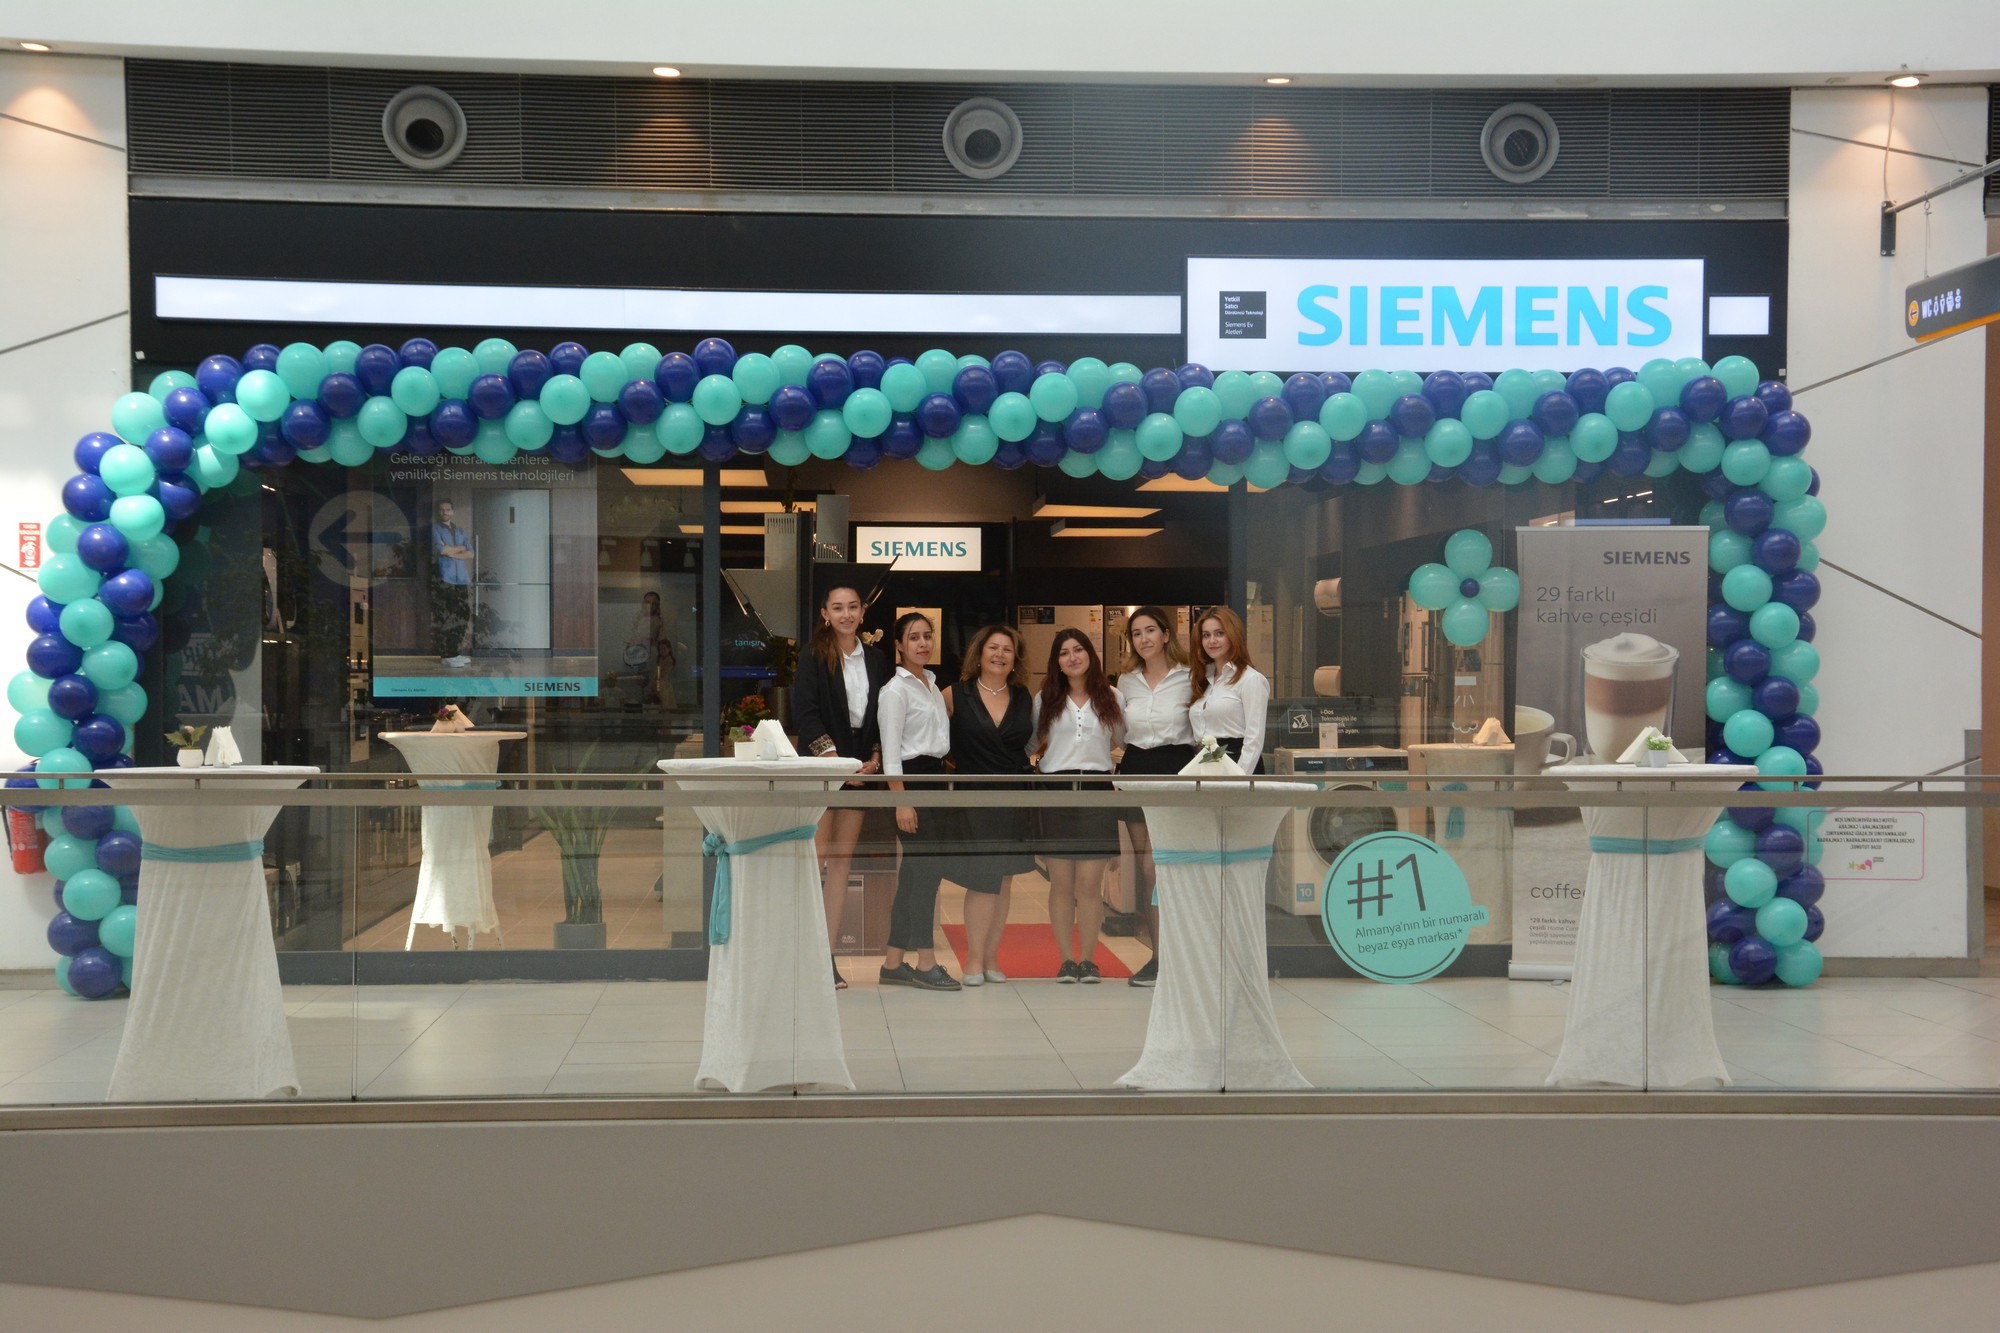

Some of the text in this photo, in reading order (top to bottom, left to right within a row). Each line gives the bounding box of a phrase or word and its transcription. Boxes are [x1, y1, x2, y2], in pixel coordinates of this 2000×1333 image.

[1297, 284, 1672, 347] SIEMENS
[1921, 298, 1932, 319] WC
[390, 452, 447, 466] Geleceği
[450, 454, 489, 465] mera
[390, 469, 574, 483] yenilikçi Siemens teknolojileri
[871, 541, 967, 557] SIEMENS
[1603, 551, 1690, 565] SIEMENS
[1536, 586, 1615, 602] 29 farklı
[1537, 607, 1657, 626] kahve çeşidi
[524, 682, 581, 692] SIEMENS
[1300, 888, 1312, 897] 10
[1347, 853, 1426, 919] #1
[1530, 883, 1586, 899] coffe
[1355, 910, 1485, 938] Almanya'nın bir numaralı
[1358, 941, 1389, 954] beyaz
[1391, 936, 1415, 950] eşya
